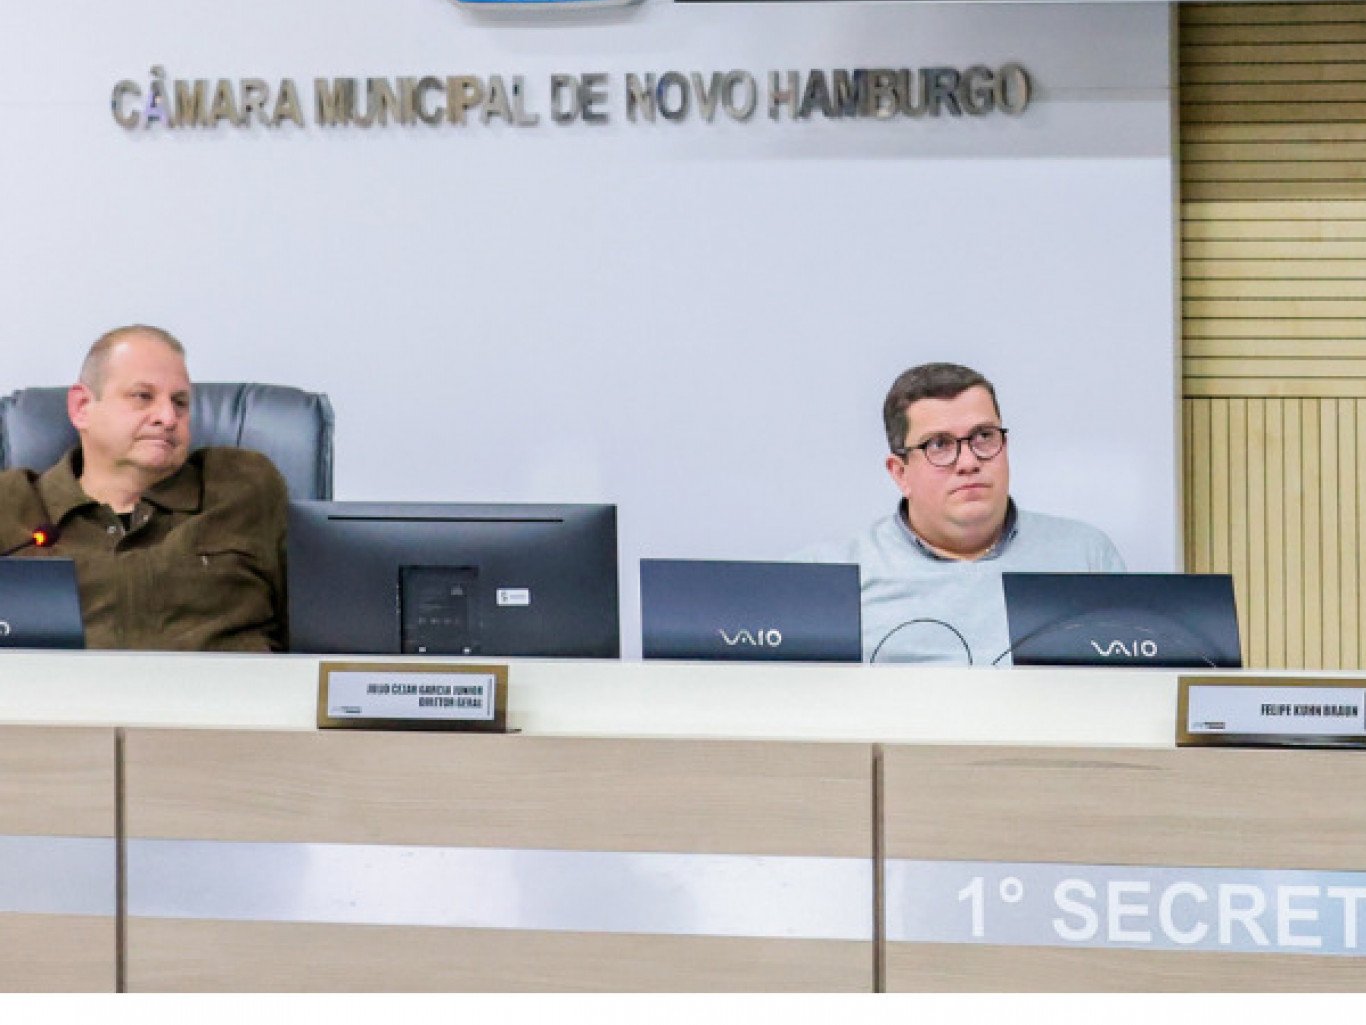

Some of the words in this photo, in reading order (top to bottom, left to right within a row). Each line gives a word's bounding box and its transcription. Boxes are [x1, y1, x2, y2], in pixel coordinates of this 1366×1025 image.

[111, 65, 304, 130] CÂMARA
[550, 72, 610, 125] DE
[625, 70, 758, 123] NOVO
[768, 62, 1034, 120] HAMBURGO
[718, 628, 783, 648] VAIO
[1089, 639, 1158, 658] VAIO
[957, 875, 1024, 938] 1º
